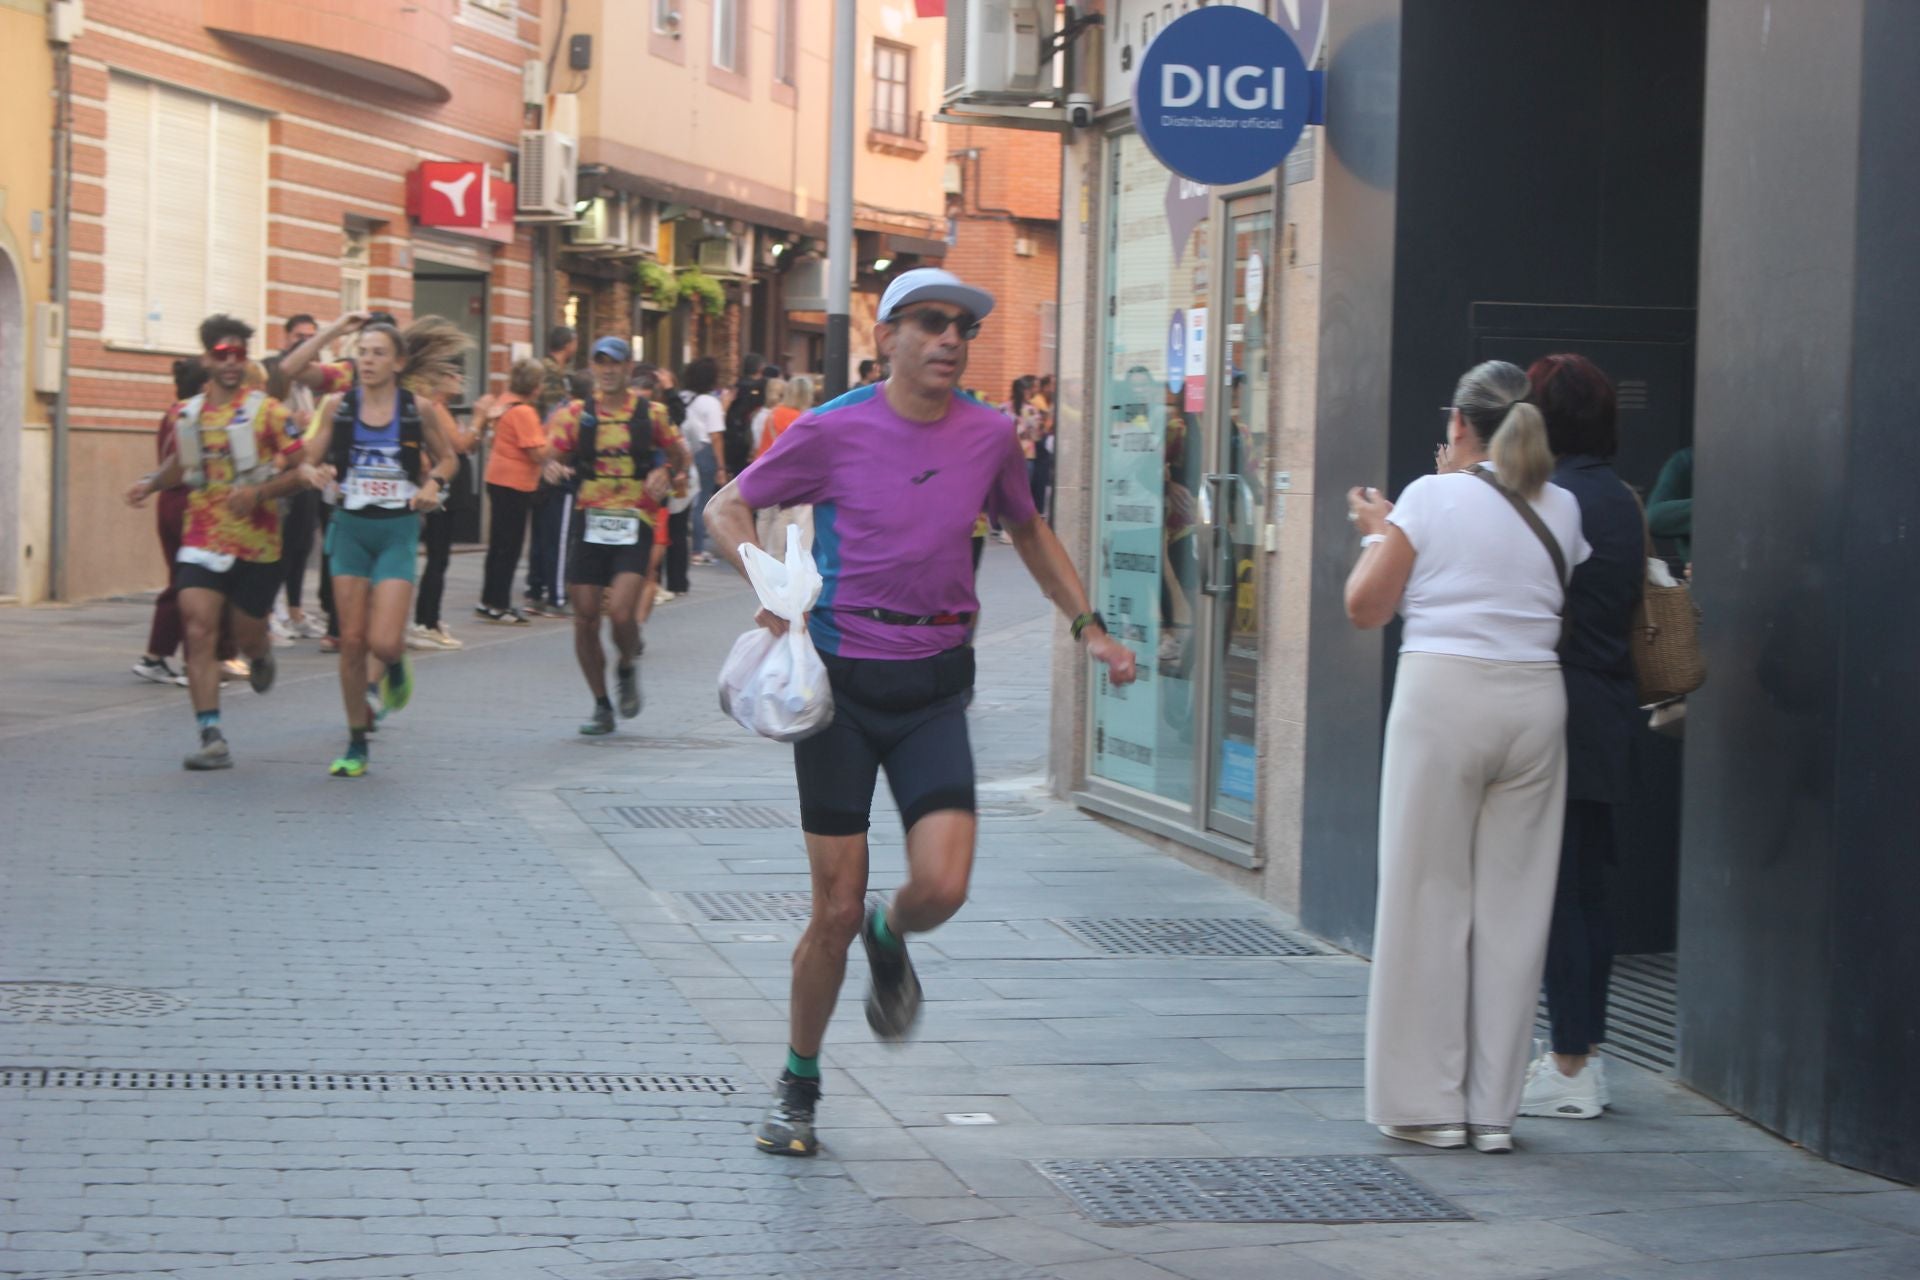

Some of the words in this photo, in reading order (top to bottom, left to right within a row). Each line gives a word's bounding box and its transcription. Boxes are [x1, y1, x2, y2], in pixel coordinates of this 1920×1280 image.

[1161, 63, 1285, 110] DIGI
[1160, 114, 1238, 129] Distribuidor
[1241, 116, 1284, 130] oficial
[362, 481, 398, 497] 1951
